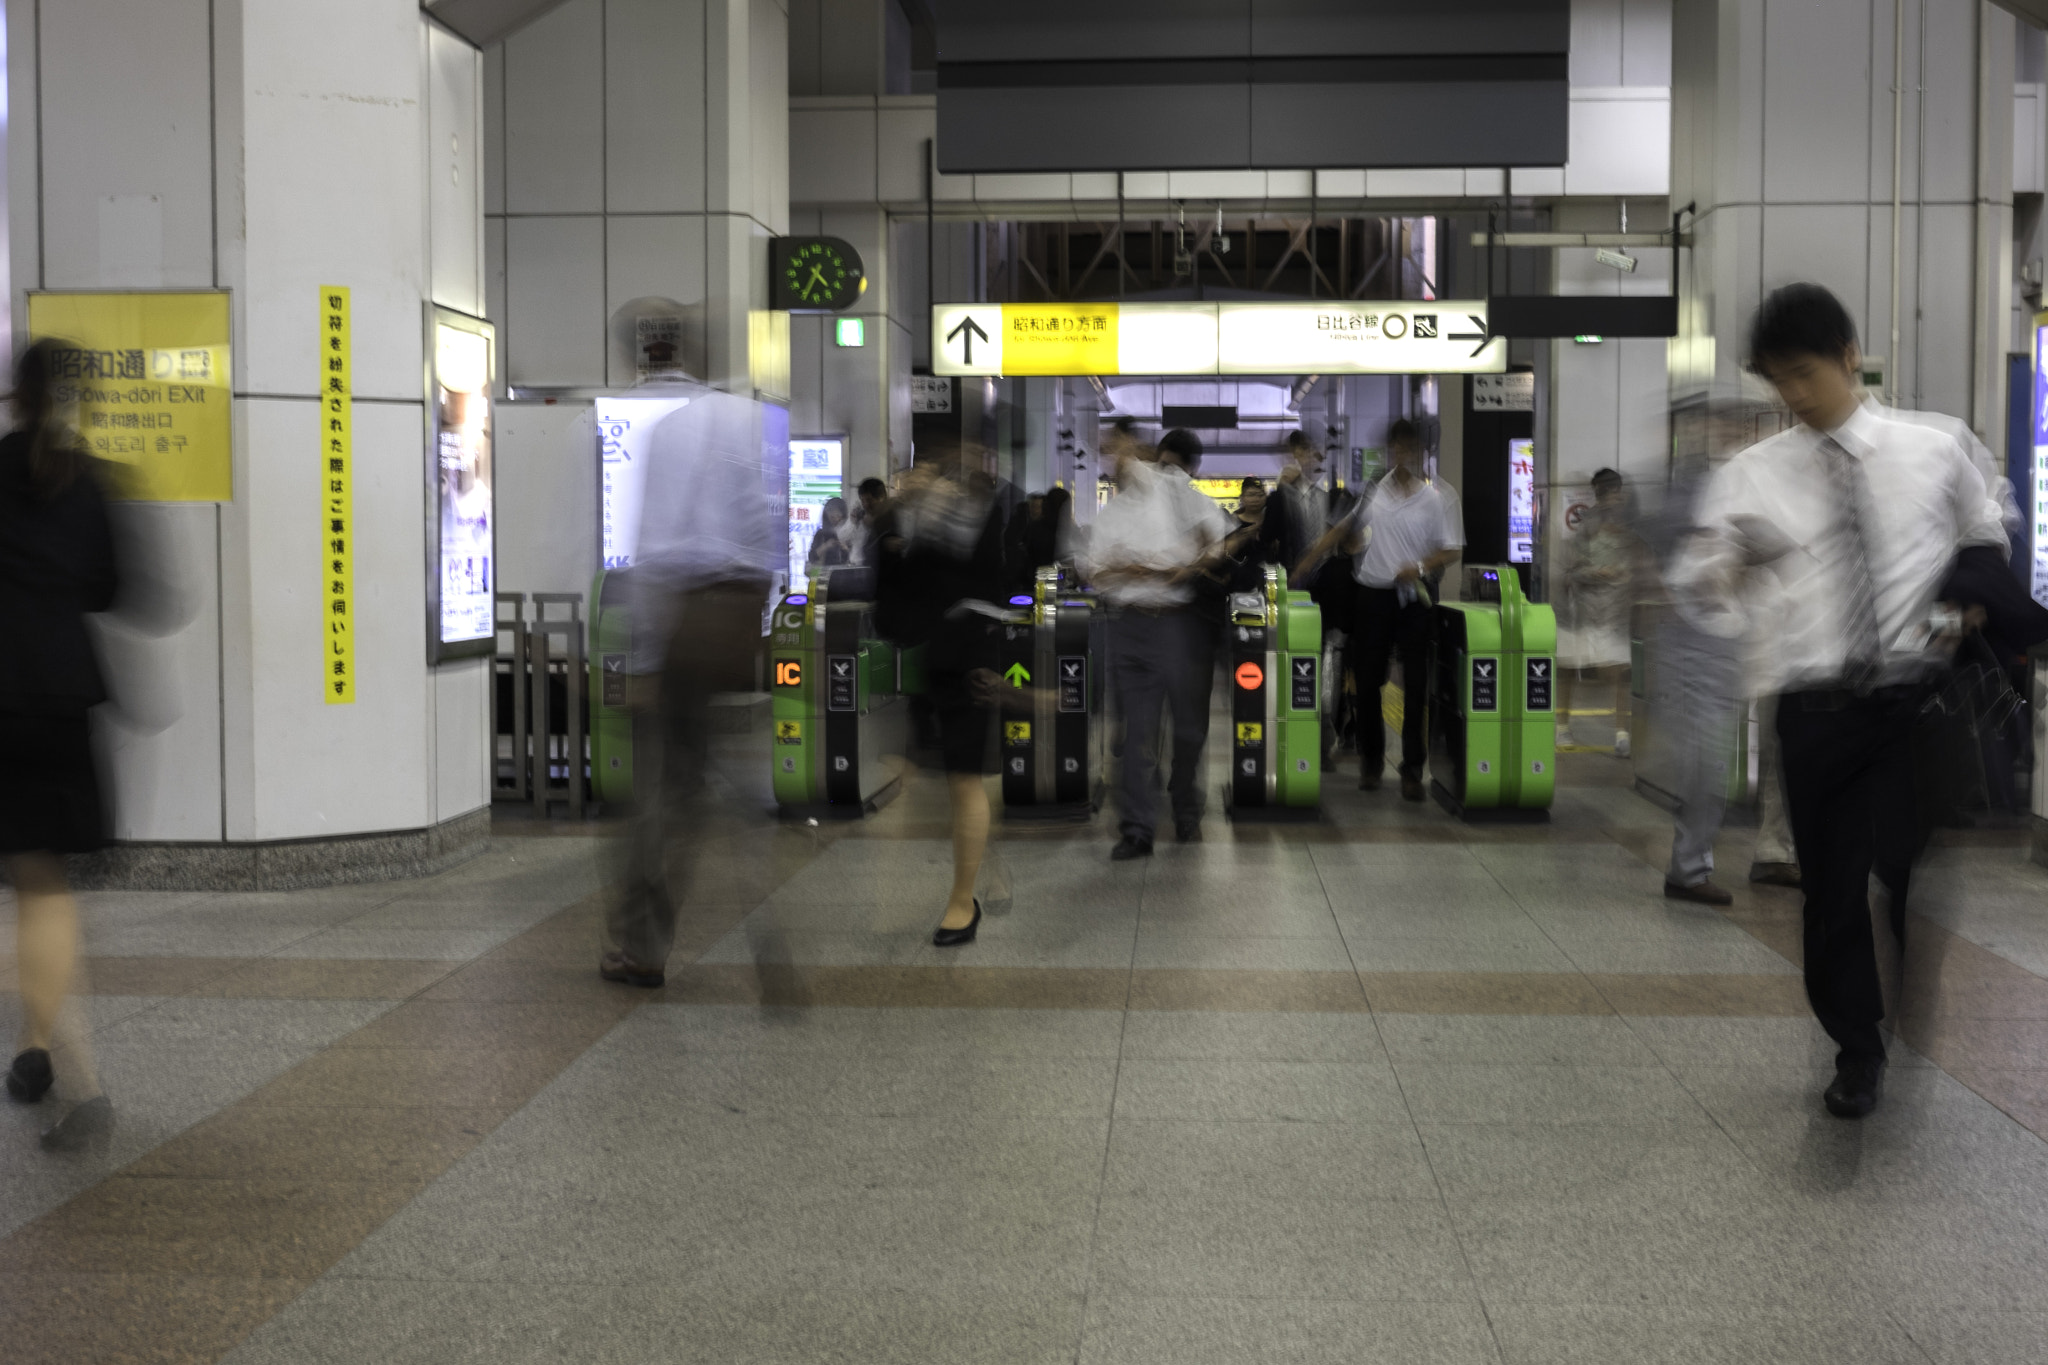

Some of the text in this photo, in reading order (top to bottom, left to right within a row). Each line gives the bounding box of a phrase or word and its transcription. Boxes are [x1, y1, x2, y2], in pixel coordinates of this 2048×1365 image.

[1013, 316, 1106, 331] 昭和通り方面
[1318, 315, 1379, 330] 日比谷線
[52, 349, 209, 380] 昭和通り口
[92, 412, 173, 429] 昭和路出口
[155, 436, 188, 453] 출구
[775, 611, 803, 629] IC
[776, 662, 801, 686] IC
